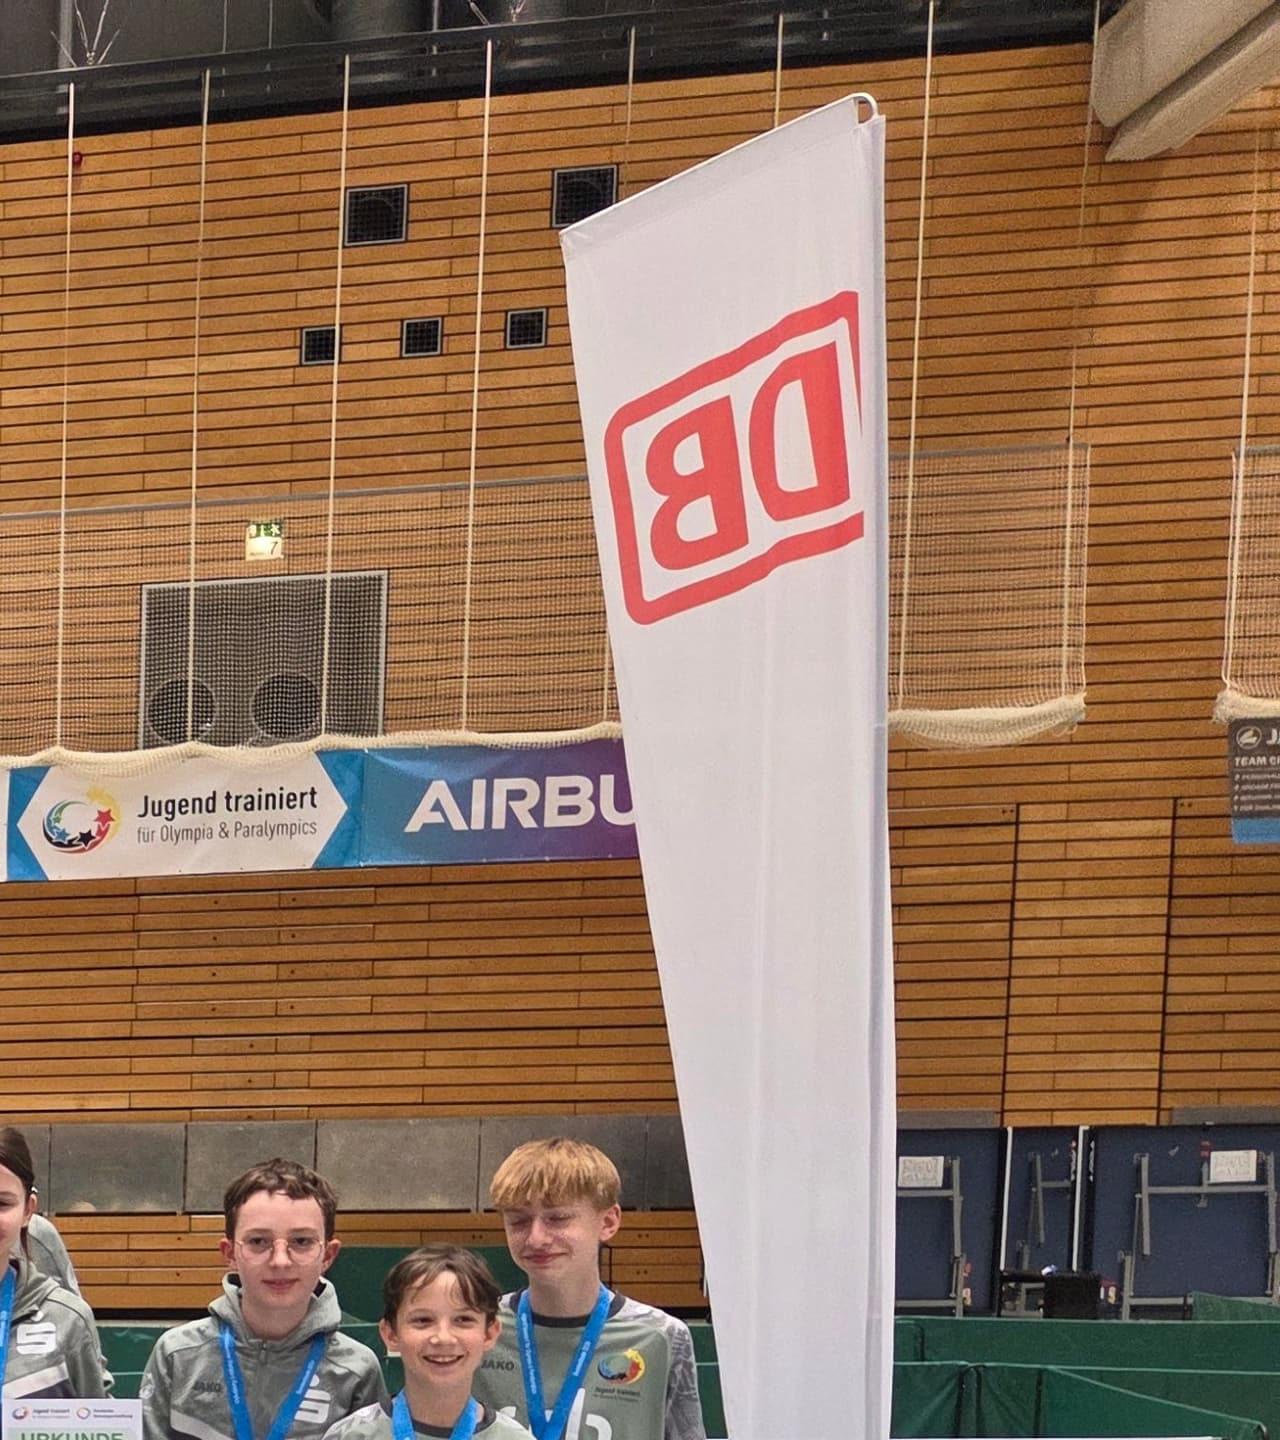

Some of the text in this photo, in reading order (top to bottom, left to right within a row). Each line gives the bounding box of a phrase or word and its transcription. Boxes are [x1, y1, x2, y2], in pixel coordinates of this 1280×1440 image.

[137, 787, 318, 819] Jugend trainiert
[404, 774, 637, 835] AIRBU
[137, 818, 318, 846] für Olympia & Paralympics
